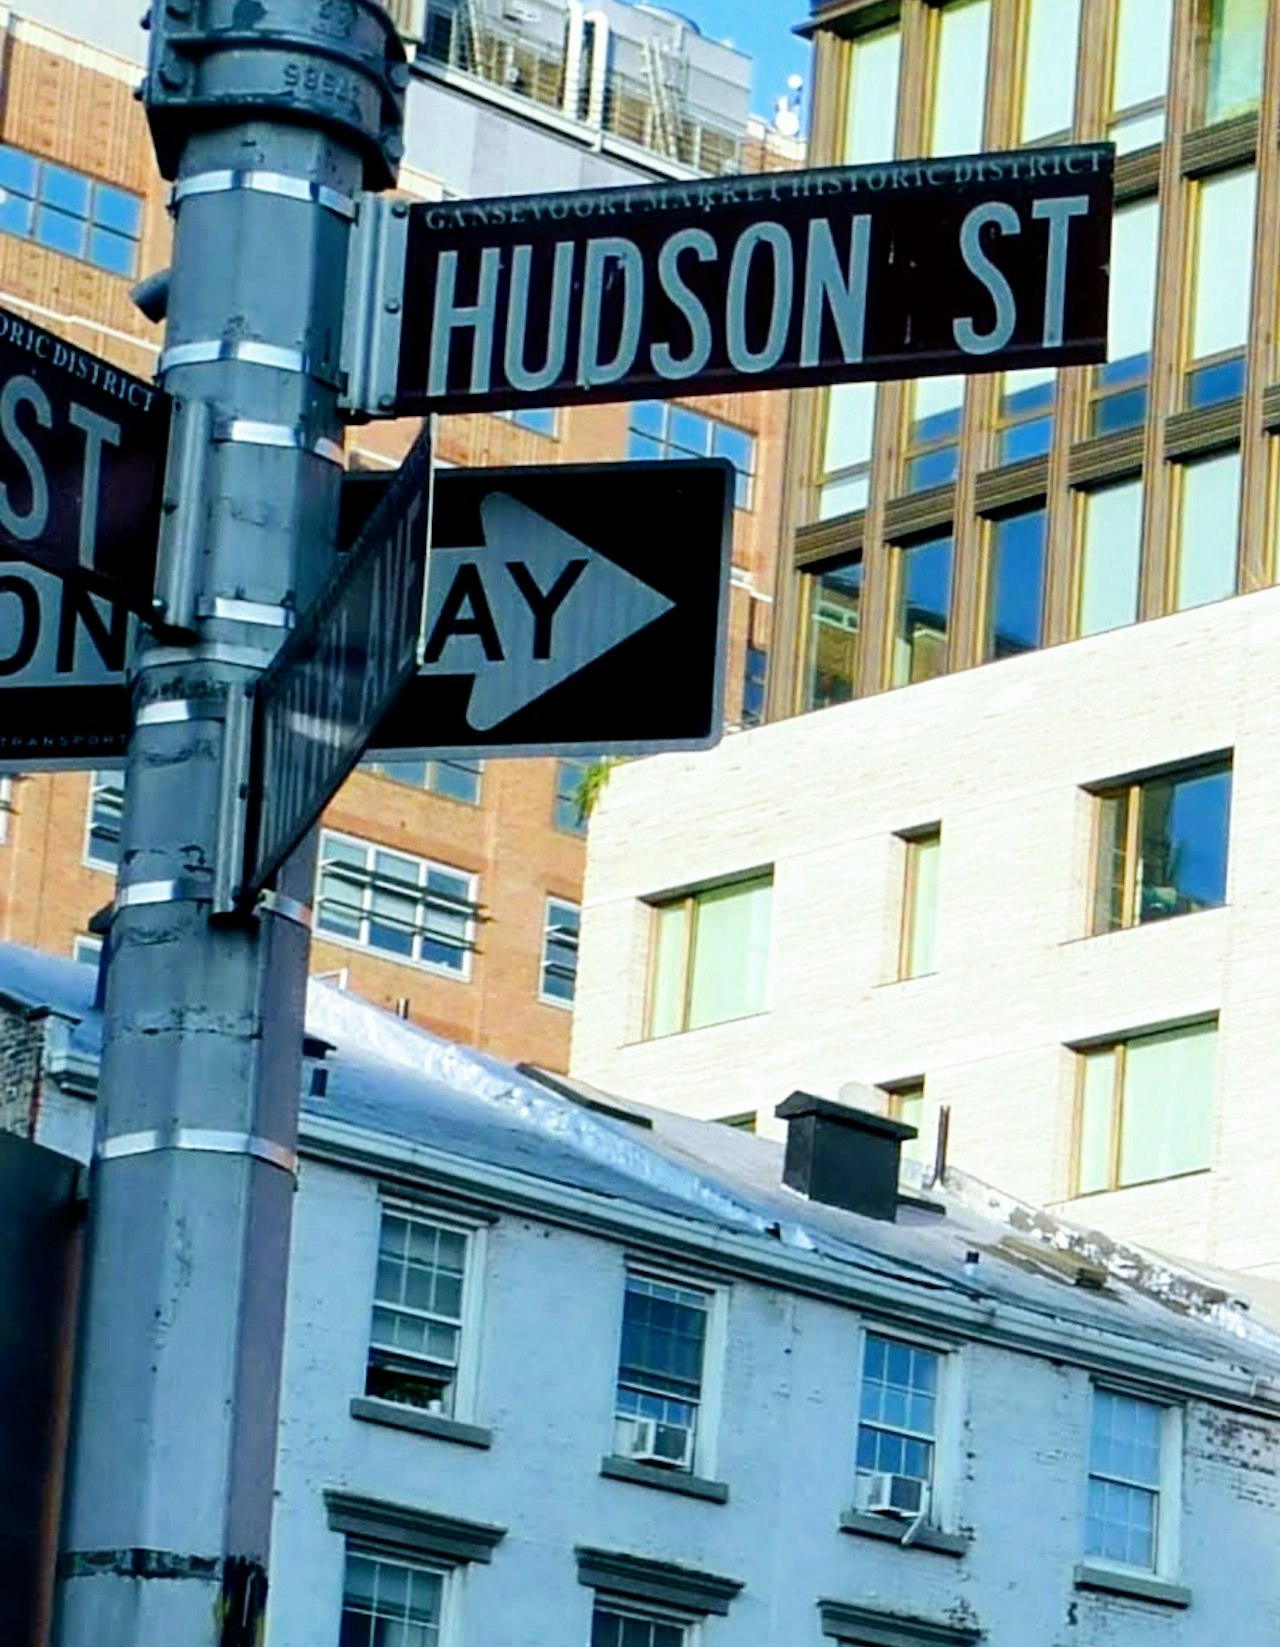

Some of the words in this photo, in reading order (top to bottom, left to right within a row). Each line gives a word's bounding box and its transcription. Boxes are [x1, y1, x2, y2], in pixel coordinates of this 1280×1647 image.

[426, 191, 633, 230] GANSEVOORT
[792, 166, 946, 197] HISTORIC
[953, 150, 1105, 184] DISTRICT
[426, 214, 872, 397] HUDSON
[952, 195, 1090, 356] ST
[53, 344, 155, 412] DISTRICT
[0, 374, 121, 571] ST
[422, 558, 589, 664] AY
[0, 734, 128, 748] TRANSPORT
